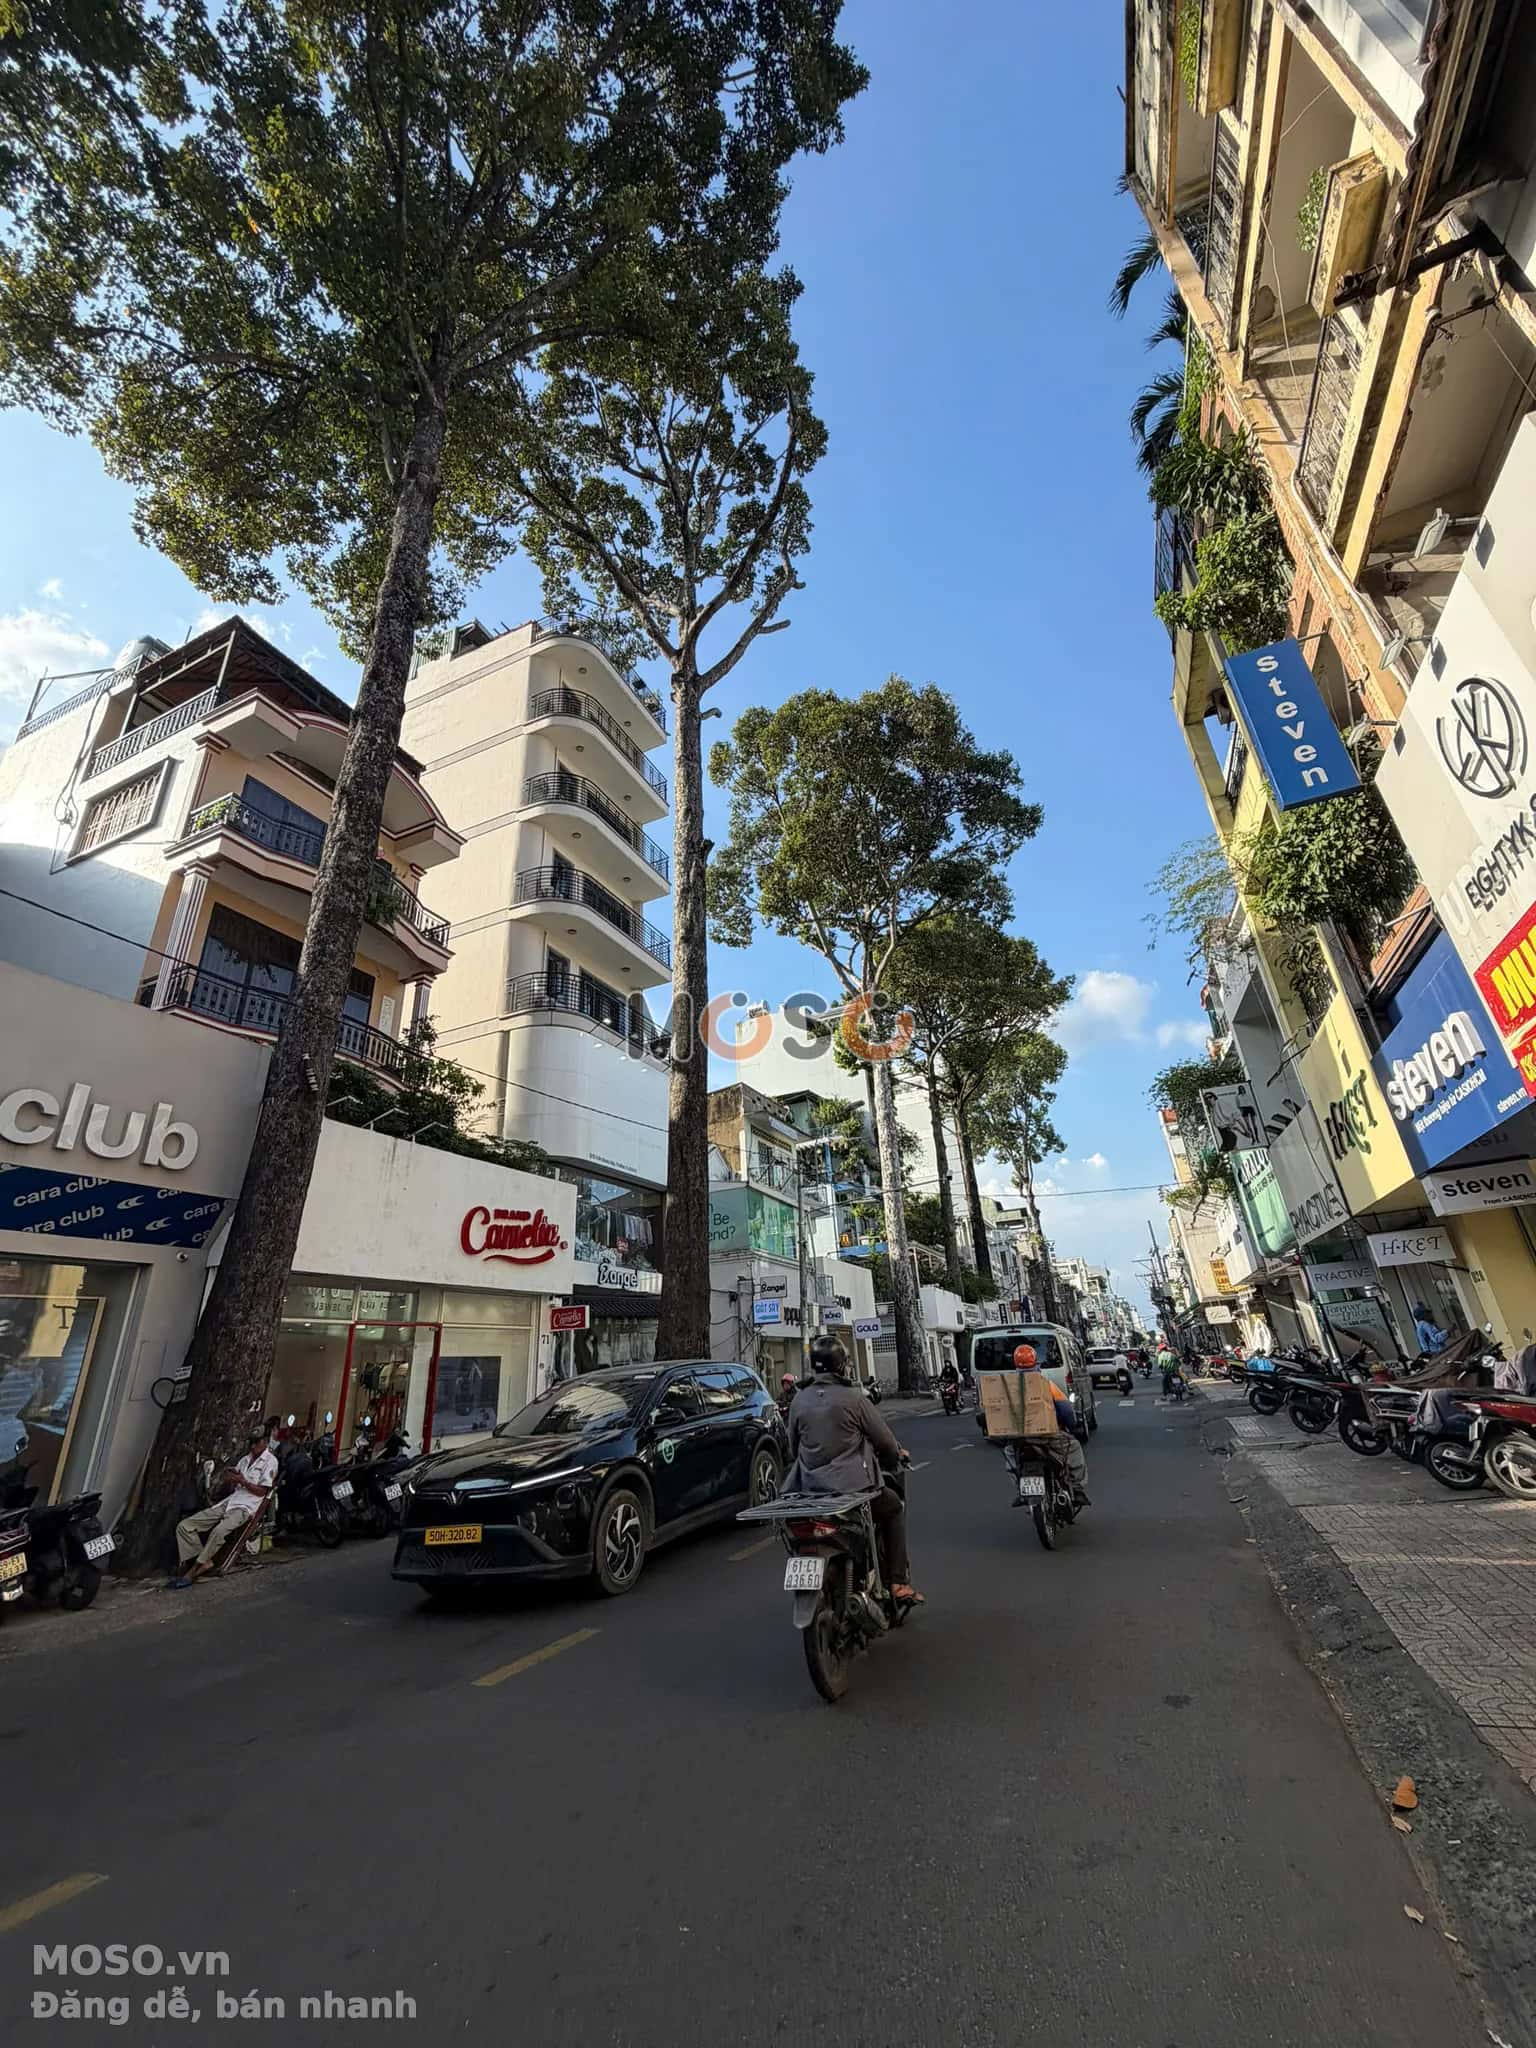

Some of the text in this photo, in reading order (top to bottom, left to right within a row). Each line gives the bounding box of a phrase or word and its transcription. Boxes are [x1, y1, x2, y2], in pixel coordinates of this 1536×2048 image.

[1256, 655, 1329, 788] steven
[1387, 1010, 1486, 1121] steven
[0, 1081, 200, 1171] club
[13, 1185, 62, 1207] cara
[1442, 1171, 1532, 1198] steven
[59, 1204, 105, 1227] club
[713, 1213, 731, 1226] Be
[1314, 1267, 1373, 1282] RYACTIVE
